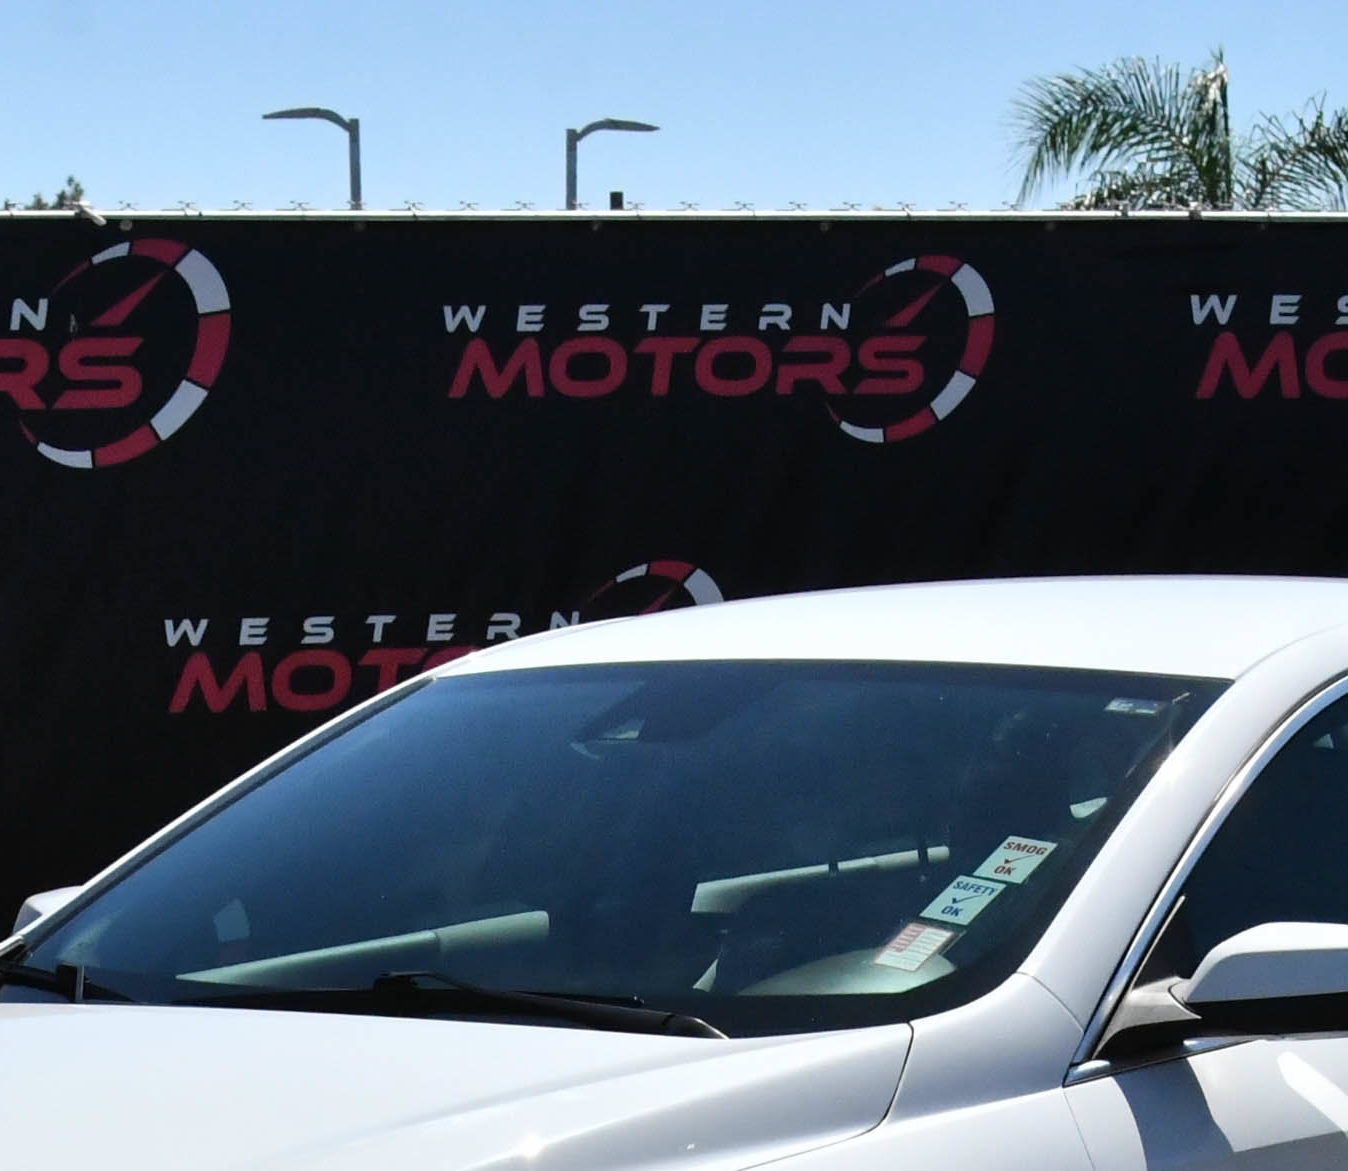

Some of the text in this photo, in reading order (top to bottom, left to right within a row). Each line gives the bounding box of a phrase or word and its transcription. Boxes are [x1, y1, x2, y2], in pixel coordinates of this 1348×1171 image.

[443, 303, 851, 333] WESTERN
[448, 335, 928, 398] MOTORS
[168, 646, 478, 713] MOT
[1003, 841, 1048, 856] SMOG
[993, 865, 1017, 876] OK
[952, 880, 998, 896] SAFETY
[941, 905, 964, 917] OK
